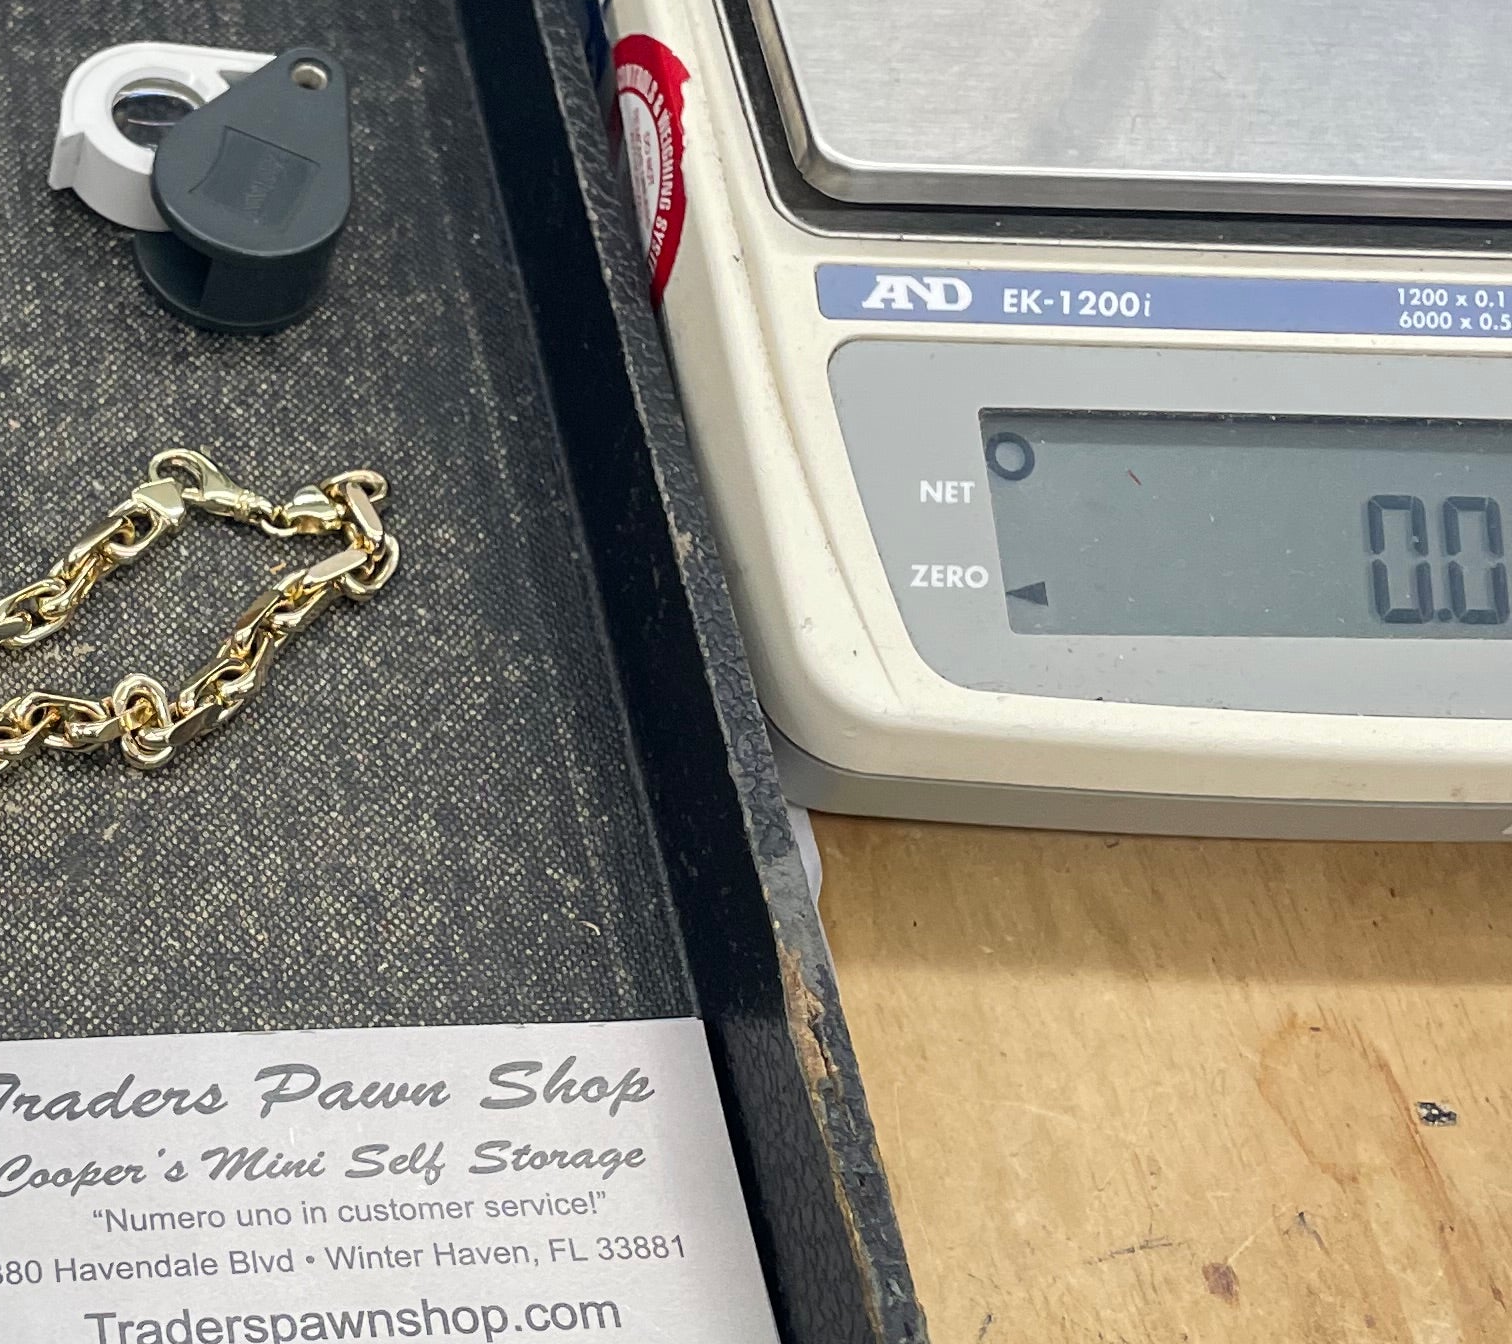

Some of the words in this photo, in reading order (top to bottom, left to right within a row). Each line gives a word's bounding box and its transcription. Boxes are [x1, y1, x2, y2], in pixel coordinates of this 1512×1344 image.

[861, 273, 974, 312] AND
[1001, 287, 1153, 318] EK-1200i
[1396, 287, 1449, 308] 1200
[1454, 293, 1470, 308] x
[1474, 288, 1506, 309] 0.1
[1398, 310, 1454, 331] 6000
[1458, 315, 1474, 330] x
[1478, 312, 1512, 332] 0.5
[919, 479, 976, 505] NET
[909, 563, 990, 590] ZERO
[253, 1062, 451, 1120] Pawn
[479, 1054, 656, 1118] Shop
[200, 1144, 326, 1182] Mini
[344, 1140, 446, 1186] Self
[468, 1139, 647, 1180] Storage
[235, 1204, 292, 1228] uno
[301, 1200, 327, 1225] in
[337, 1195, 475, 1224] customer
[54, 1253, 219, 1284] Havendale
[230, 1247, 294, 1275] Blvd
[325, 1241, 423, 1271] Winter
[432, 1237, 540, 1268] Haven,
[548, 1237, 588, 1263] FL
[596, 1234, 686, 1261] 33881
